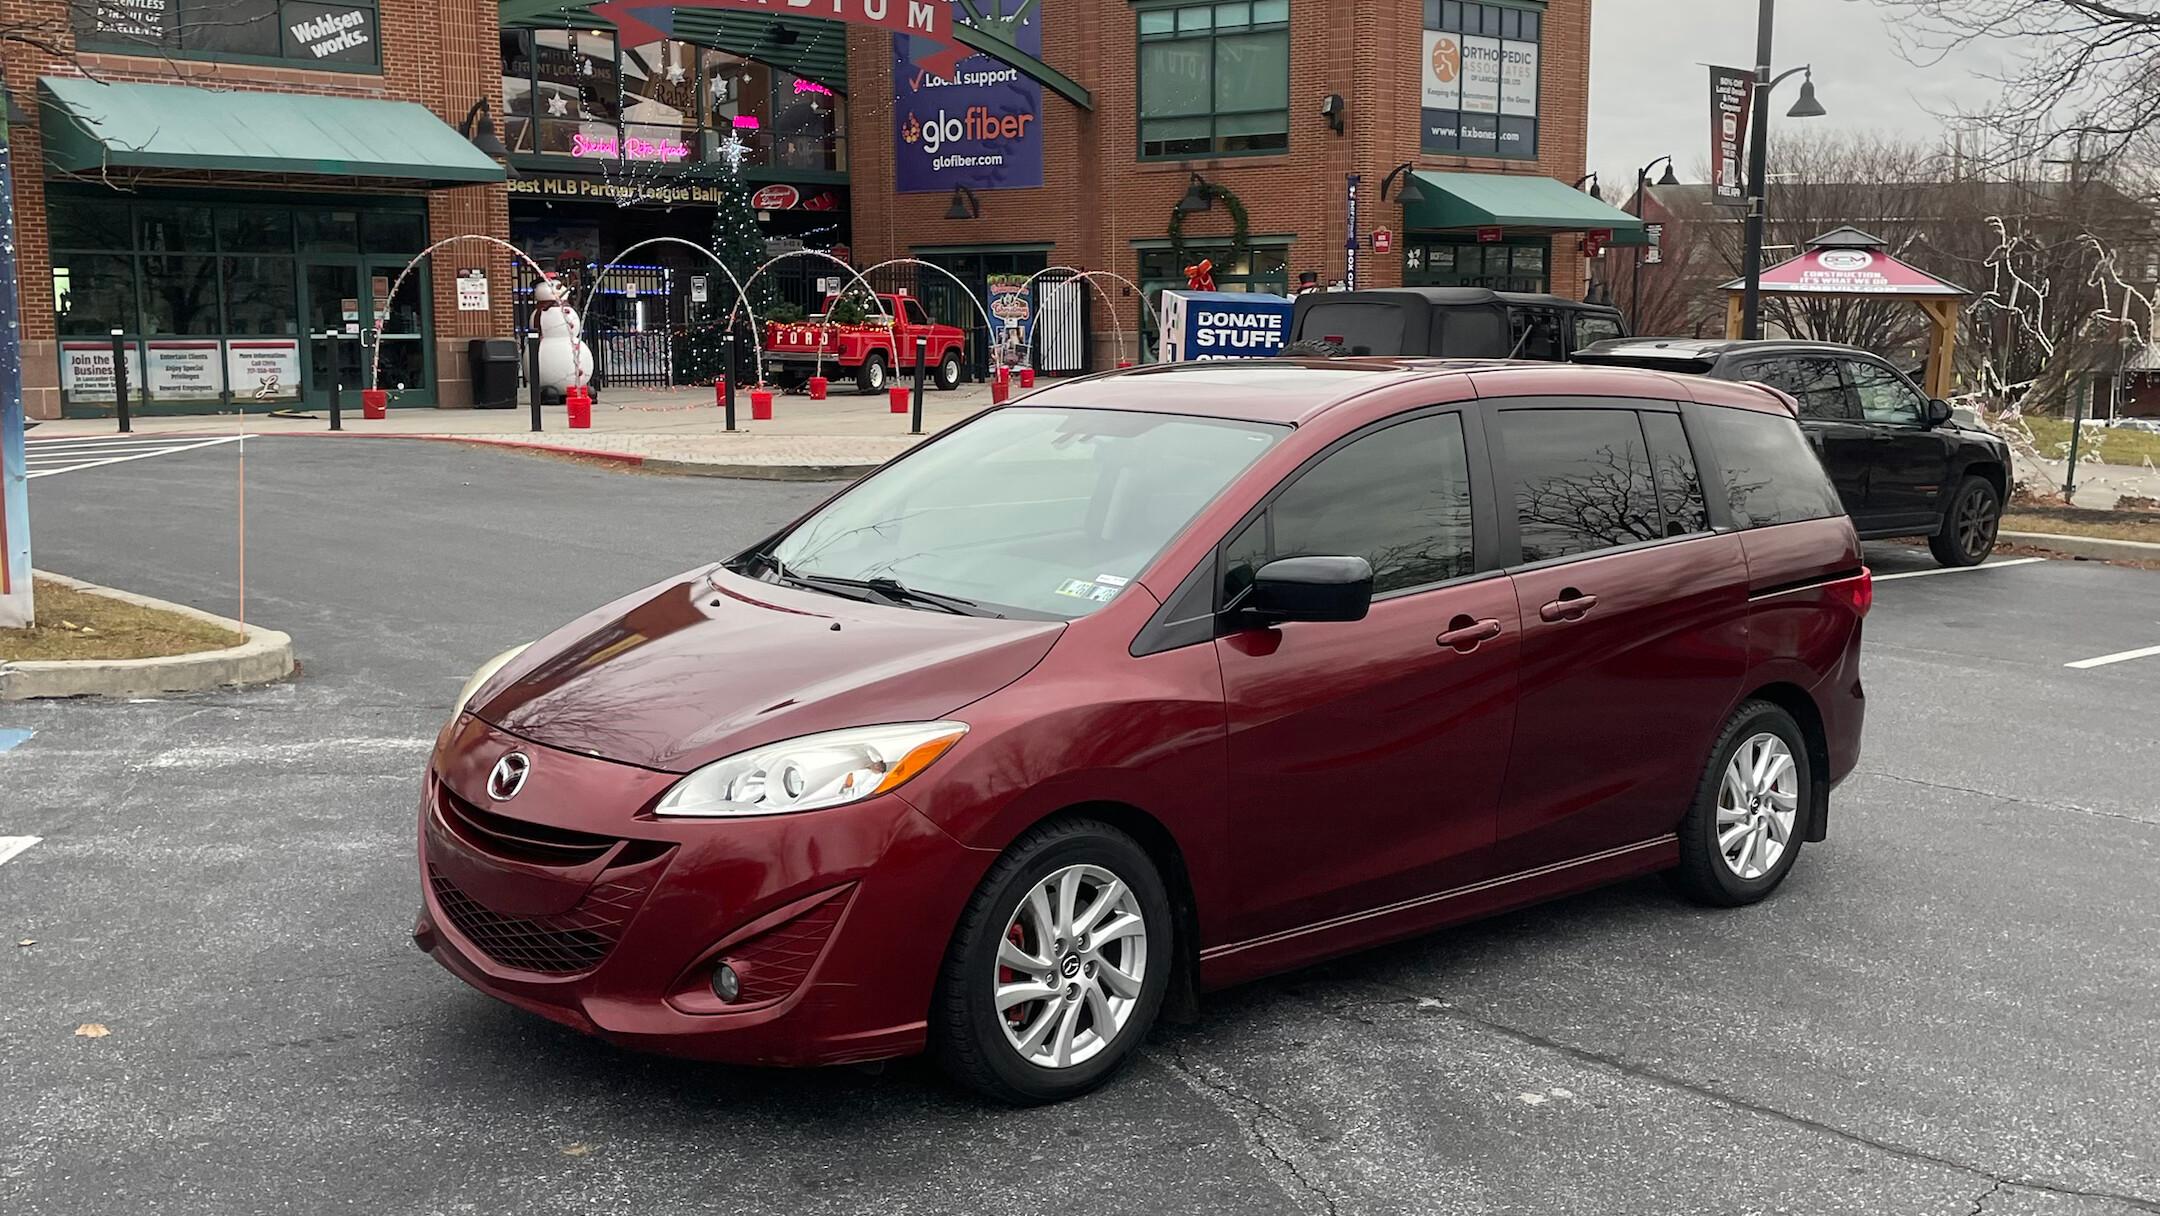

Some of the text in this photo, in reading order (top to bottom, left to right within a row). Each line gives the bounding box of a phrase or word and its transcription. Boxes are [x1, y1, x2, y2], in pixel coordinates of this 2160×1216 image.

[290, 10, 364, 43] Wohlsen
[310, 30, 369, 58] works.
[1462, 46, 1532, 65] ORTHOPEDIC
[925, 68, 1018, 88] Lol support
[1464, 61, 1531, 79] ASSOCATES
[932, 154, 1003, 171] glofiber.com
[507, 179, 541, 193] Best
[543, 179, 578, 194] MLB
[1198, 312, 1282, 328] DONATE
[776, 331, 828, 345] FORD
[1197, 329, 1284, 348] STUFF.
[71, 355, 91, 365] Join
[93, 356, 109, 365] the
